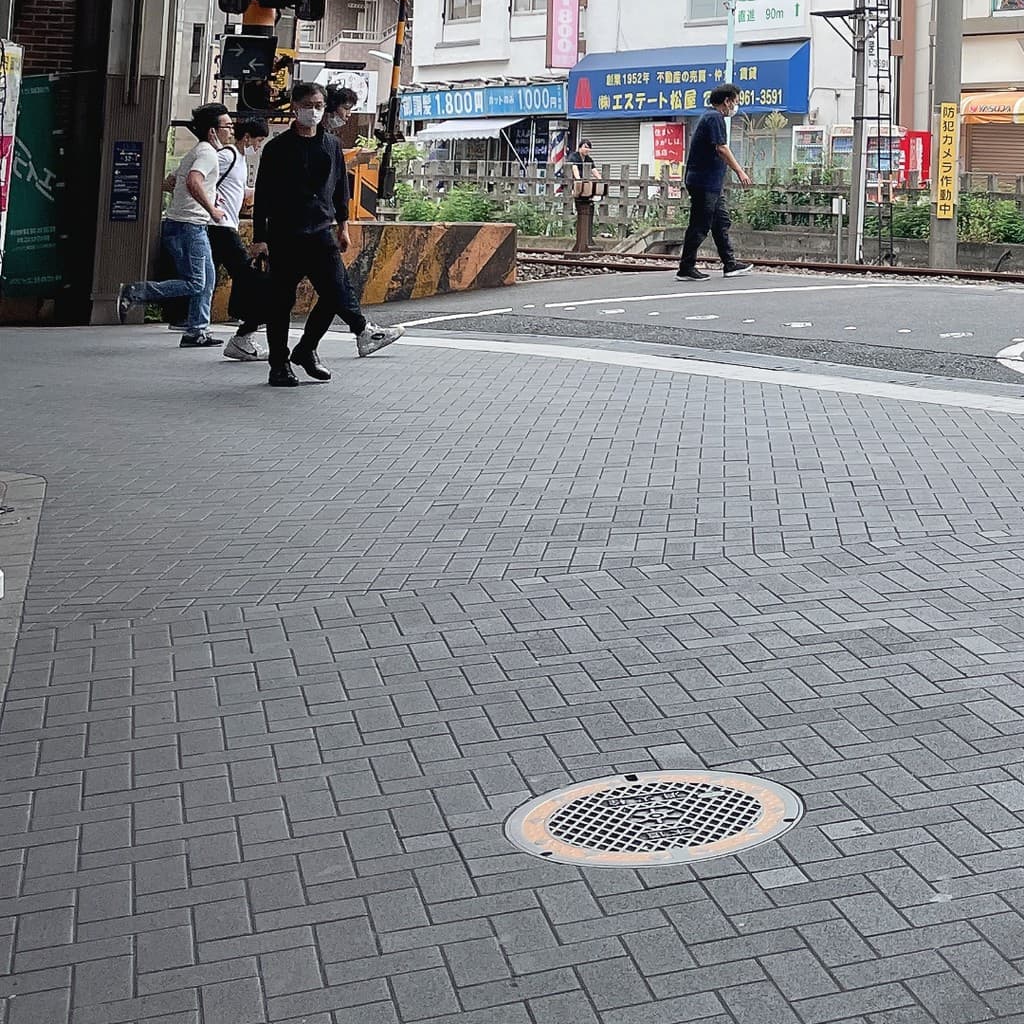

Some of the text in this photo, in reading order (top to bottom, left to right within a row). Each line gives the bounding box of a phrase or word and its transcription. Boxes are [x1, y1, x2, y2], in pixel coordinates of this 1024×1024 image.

[738, 8, 784, 23] 直進 90m
[740, 88, 782, 106] 961-3591
[978, 104, 1012, 113] YASUDA
[940, 106, 955, 216] 防犯カメラ作動中
